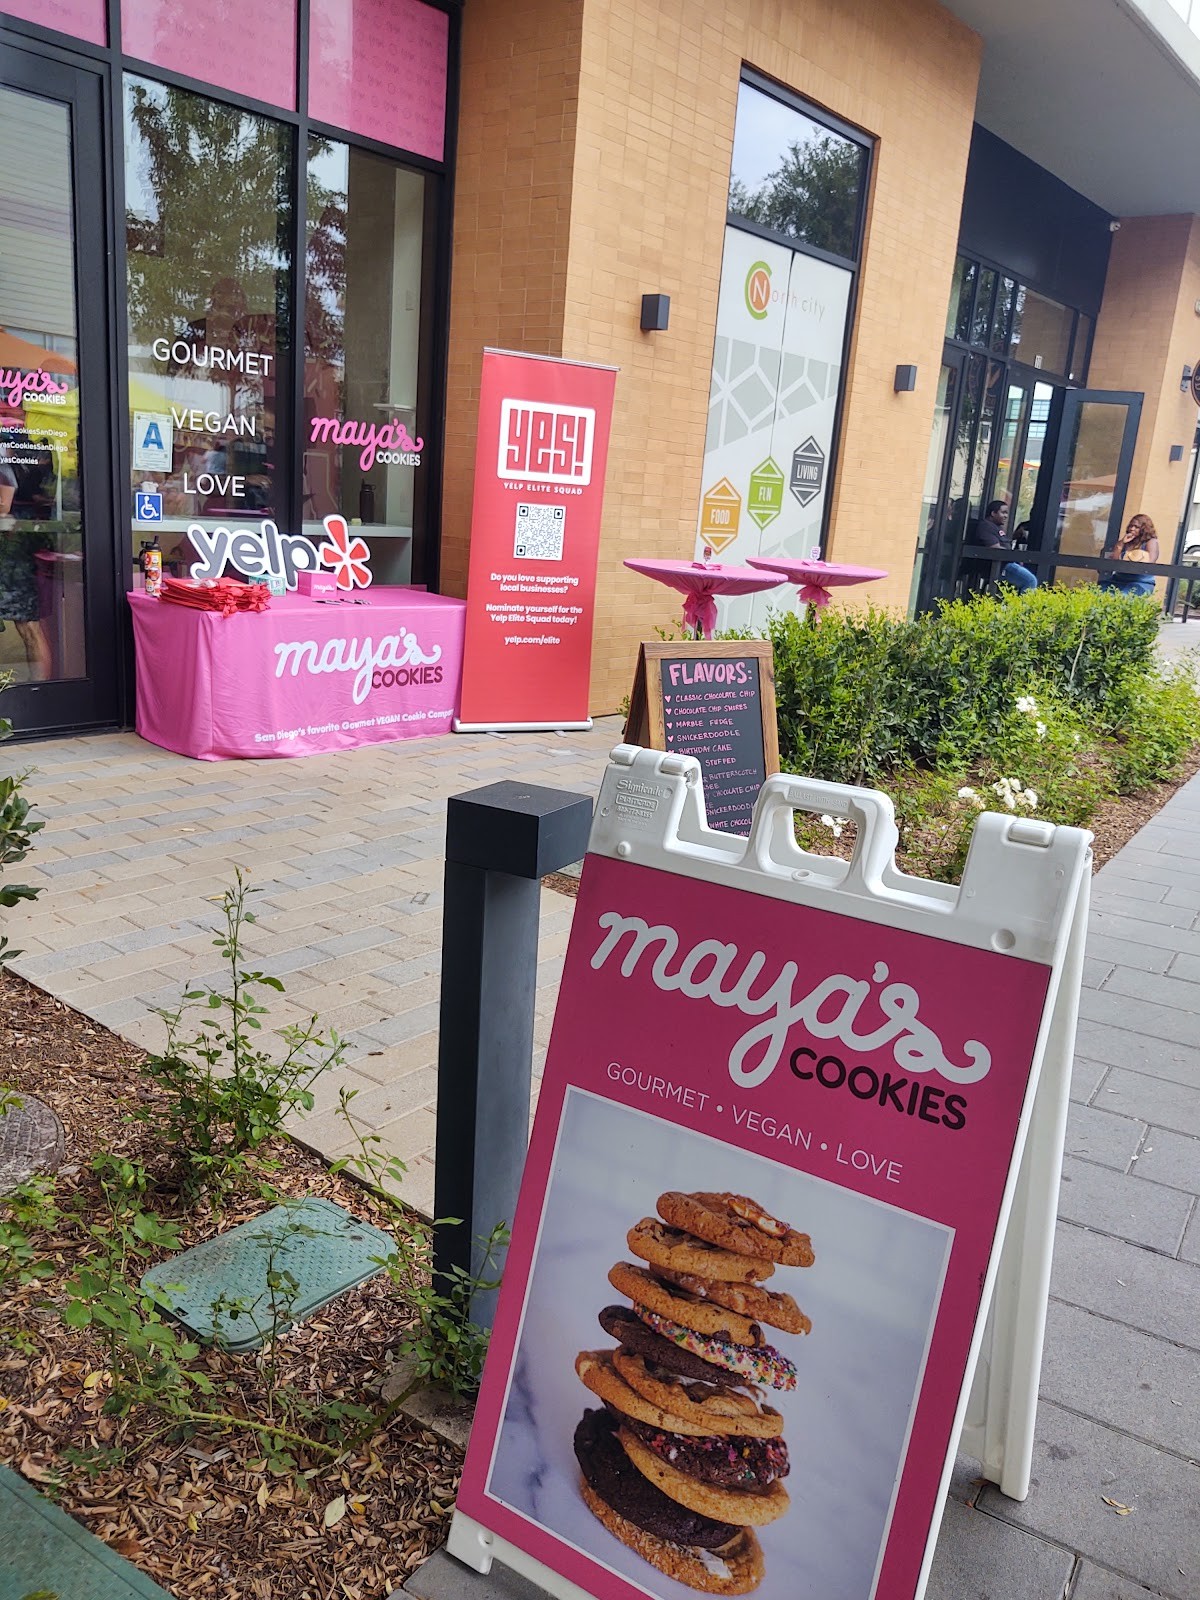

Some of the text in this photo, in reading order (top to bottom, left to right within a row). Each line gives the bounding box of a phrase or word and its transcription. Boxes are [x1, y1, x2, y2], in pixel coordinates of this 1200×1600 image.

[802, 297, 825, 322] city
[152, 338, 273, 376] GOURMET
[0, 367, 68, 407] ya's
[23, 392, 67, 405] COOKIES
[171, 407, 256, 436] VEGAN
[142, 422, 164, 450] A
[310, 417, 424, 471] maya's
[376, 451, 421, 466] COOKIES
[796, 464, 818, 481] LIVING
[182, 473, 246, 497] LOVE
[503, 482, 583, 495] YELP ELITE SQUAD
[758, 486, 773, 502] FUN
[710, 508, 730, 525] FOOD
[189, 522, 318, 588] yelp
[490, 573, 579, 586] Do you love supporting
[500, 583, 568, 593] local businesses?
[486, 603, 524, 612] Nominate
[525, 605, 558, 614] yourself
[570, 606, 583, 614] the
[490, 614, 577, 625] Yelp Elite Squad today!
[504, 635, 560, 645] yelp.com/elite
[274, 627, 442, 705] maya's
[669, 661, 752, 686] FLAVORS:
[372, 666, 443, 689] COOKIES
[704, 691, 737, 701] CHOCOLATE
[674, 706, 707, 715] CHOCOLATE
[708, 705, 721, 713] CHIP
[254, 709, 454, 743] San Diego's favorite Gourmet VEGAN Cookie Compa
[676, 718, 733, 728] MARBLE FUDGE
[677, 730, 740, 742] SNICKERDOODLE
[678, 744, 732, 755] BIRTHDAY CAKE
[705, 757, 736, 767] STUFFED
[709, 768, 757, 781] BUTTERSCOTCH
[713, 786, 744, 797] CHOCOLATE
[745, 784, 760, 793] CHIP
[706, 803, 754, 816] SNICKERDOODL
[709, 818, 752, 828] WHITE CHOCOL
[590, 911, 992, 1088] maya's
[789, 1047, 968, 1130] COOKIES
[606, 1061, 903, 1184] GOURMET VEGAN LOVE
